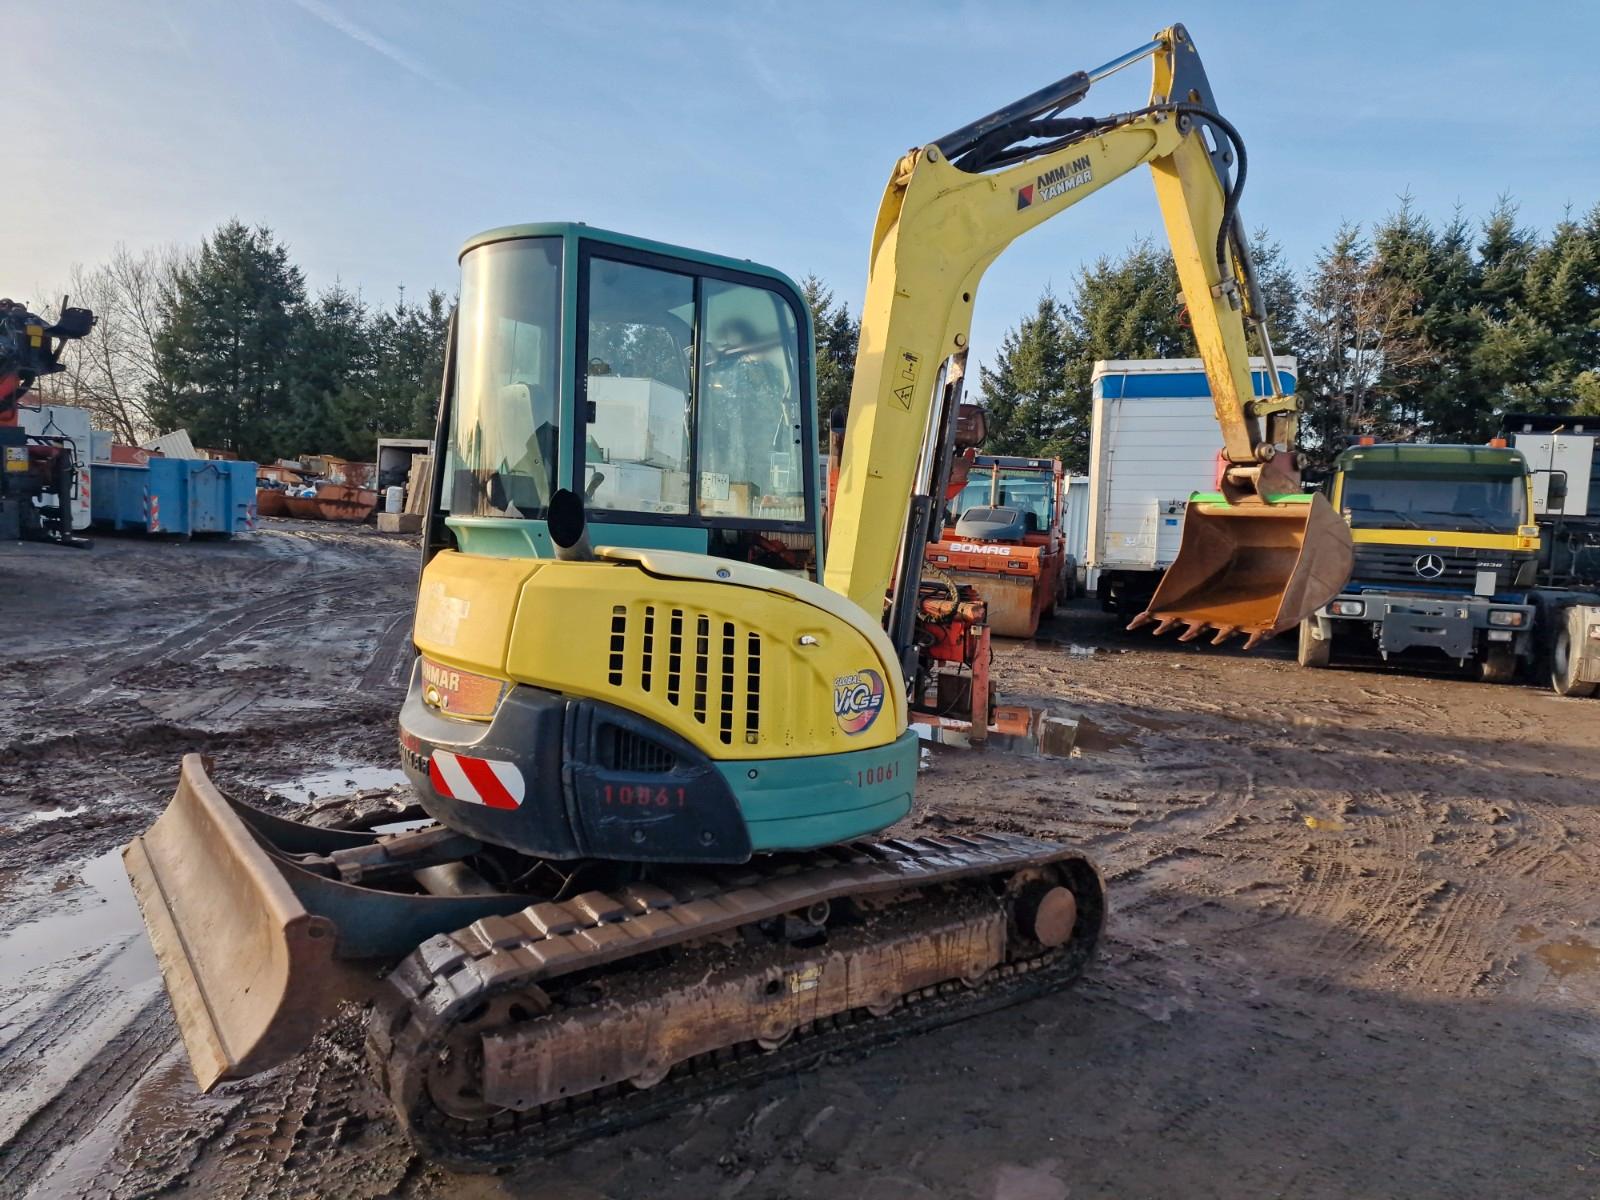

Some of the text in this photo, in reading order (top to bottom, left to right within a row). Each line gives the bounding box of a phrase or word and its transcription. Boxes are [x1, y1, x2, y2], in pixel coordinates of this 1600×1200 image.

[1037, 154, 1091, 190] AMMANN
[1039, 170, 1093, 201] YANMAR
[949, 542, 1011, 556] BOMAG
[858, 760, 898, 788] 10061
